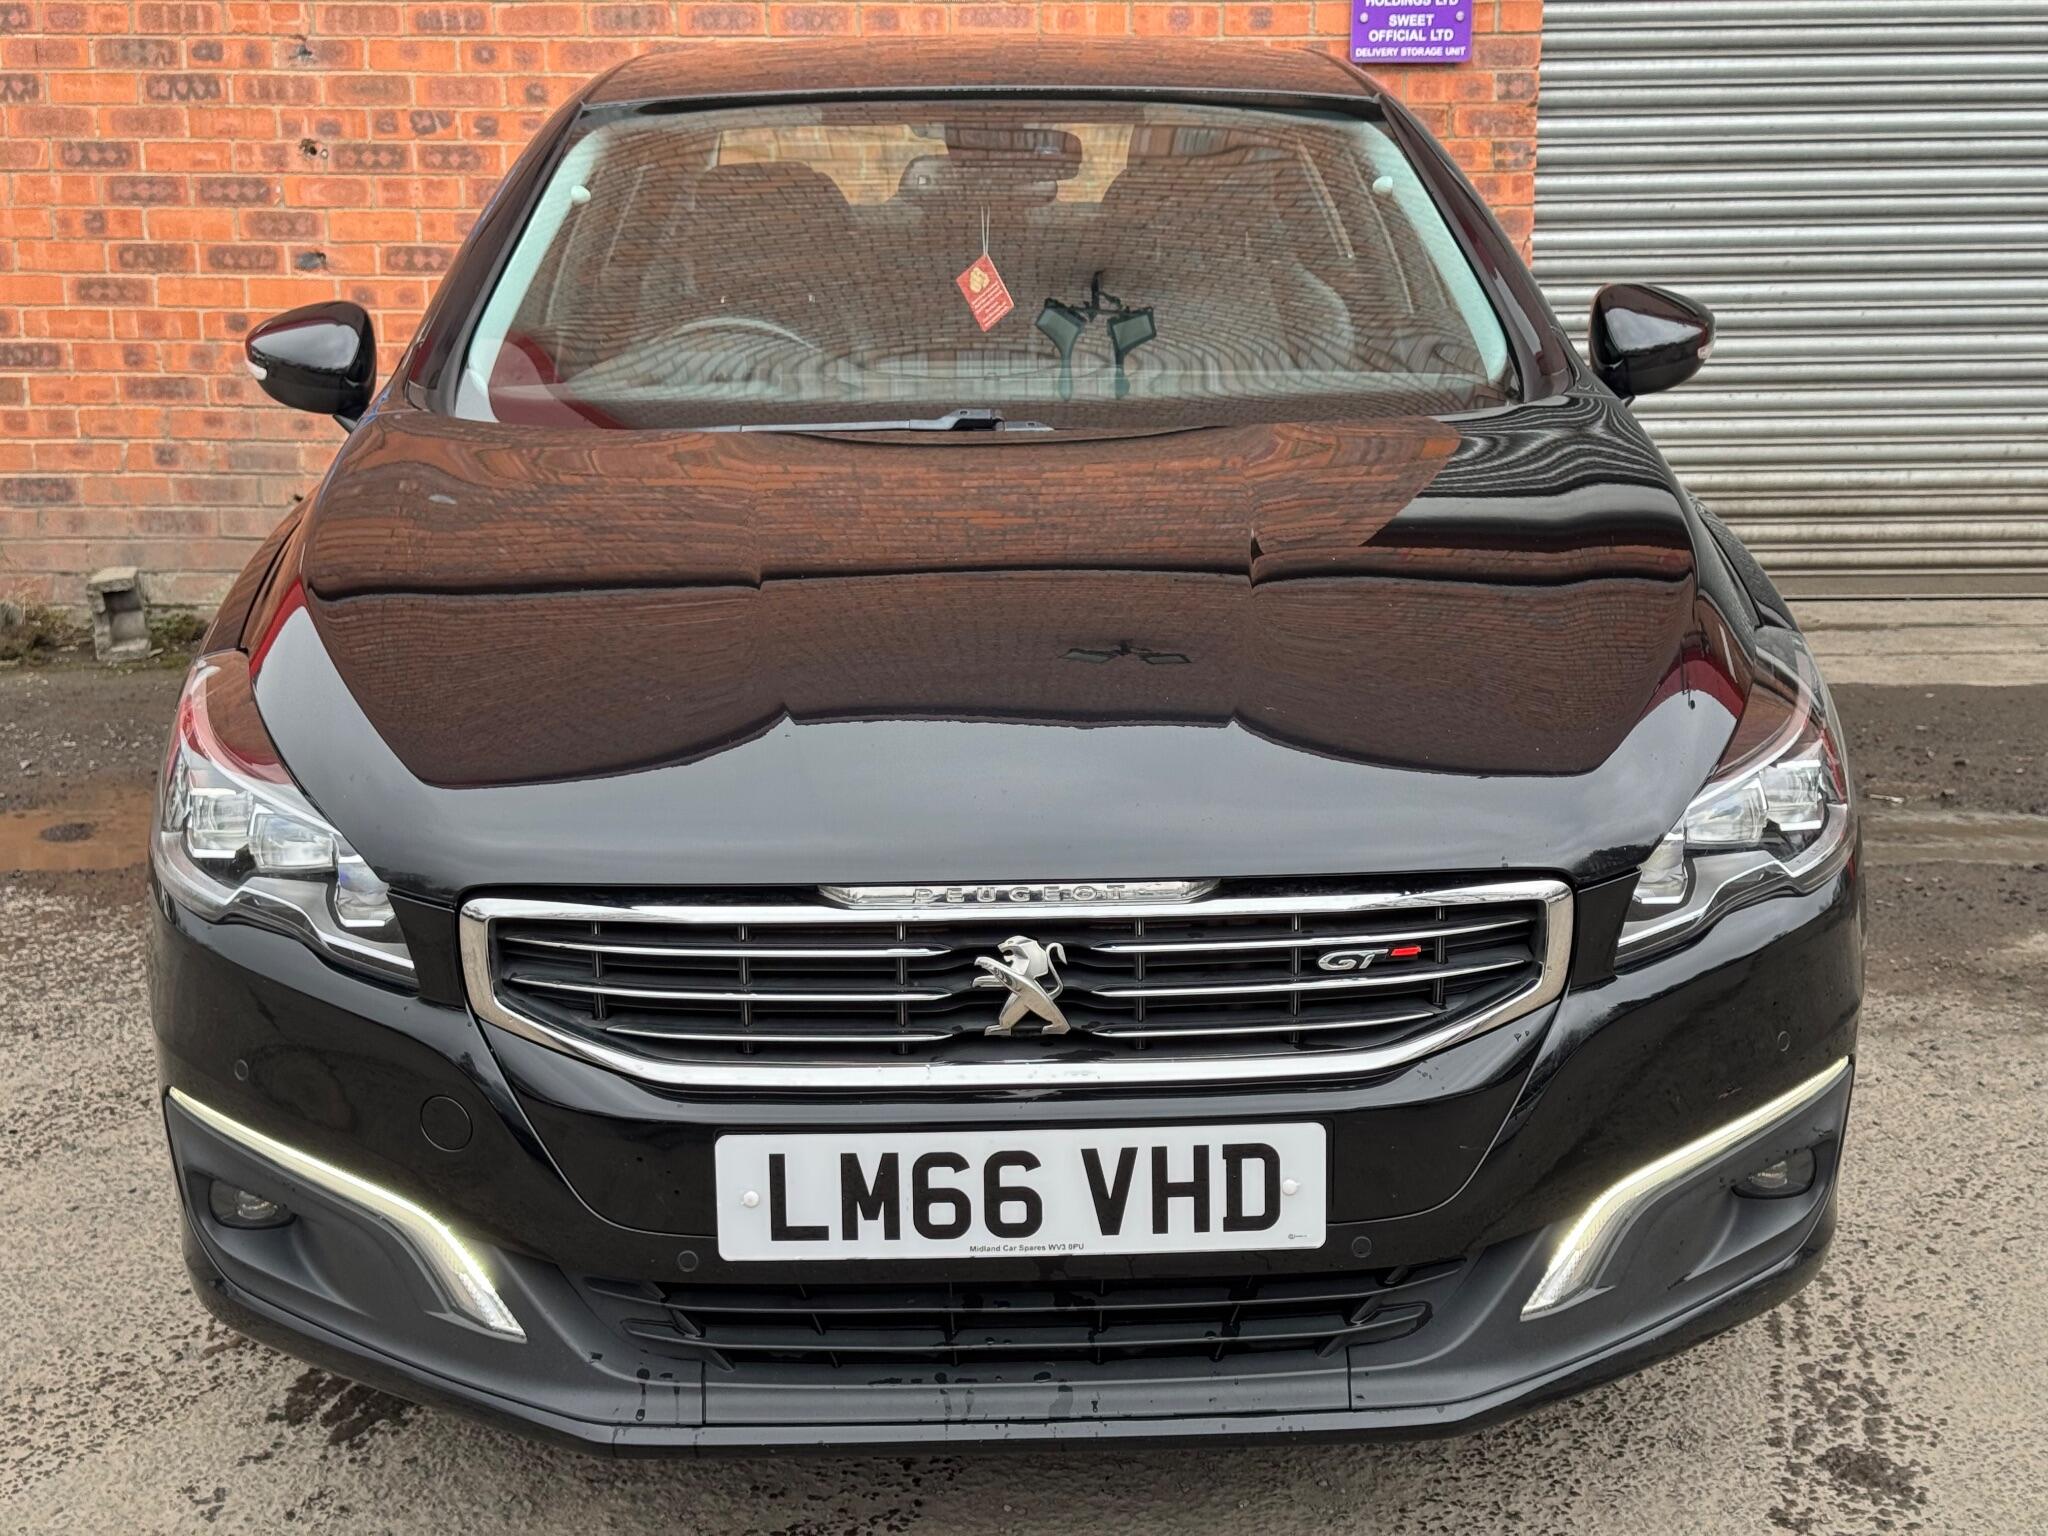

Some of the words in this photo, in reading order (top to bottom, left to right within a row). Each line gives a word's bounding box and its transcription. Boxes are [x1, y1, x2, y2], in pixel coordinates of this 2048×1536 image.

[1388, 13, 1434, 27] SWEET
[1368, 29, 1426, 42] OFFICIAL
[1430, 28, 1454, 41] LTD
[1355, 47, 1398, 57] DELIVERY
[1400, 47, 1443, 56] STORAGE
[1445, 46, 1466, 56] UNIT
[913, 885, 1125, 904] PEUGEOT
[768, 1150, 1043, 1242] LM66
[1081, 1142, 1282, 1236] VHD
[1002, 1244, 1017, 1252] Car
[1018, 1244, 1046, 1253] Spares
